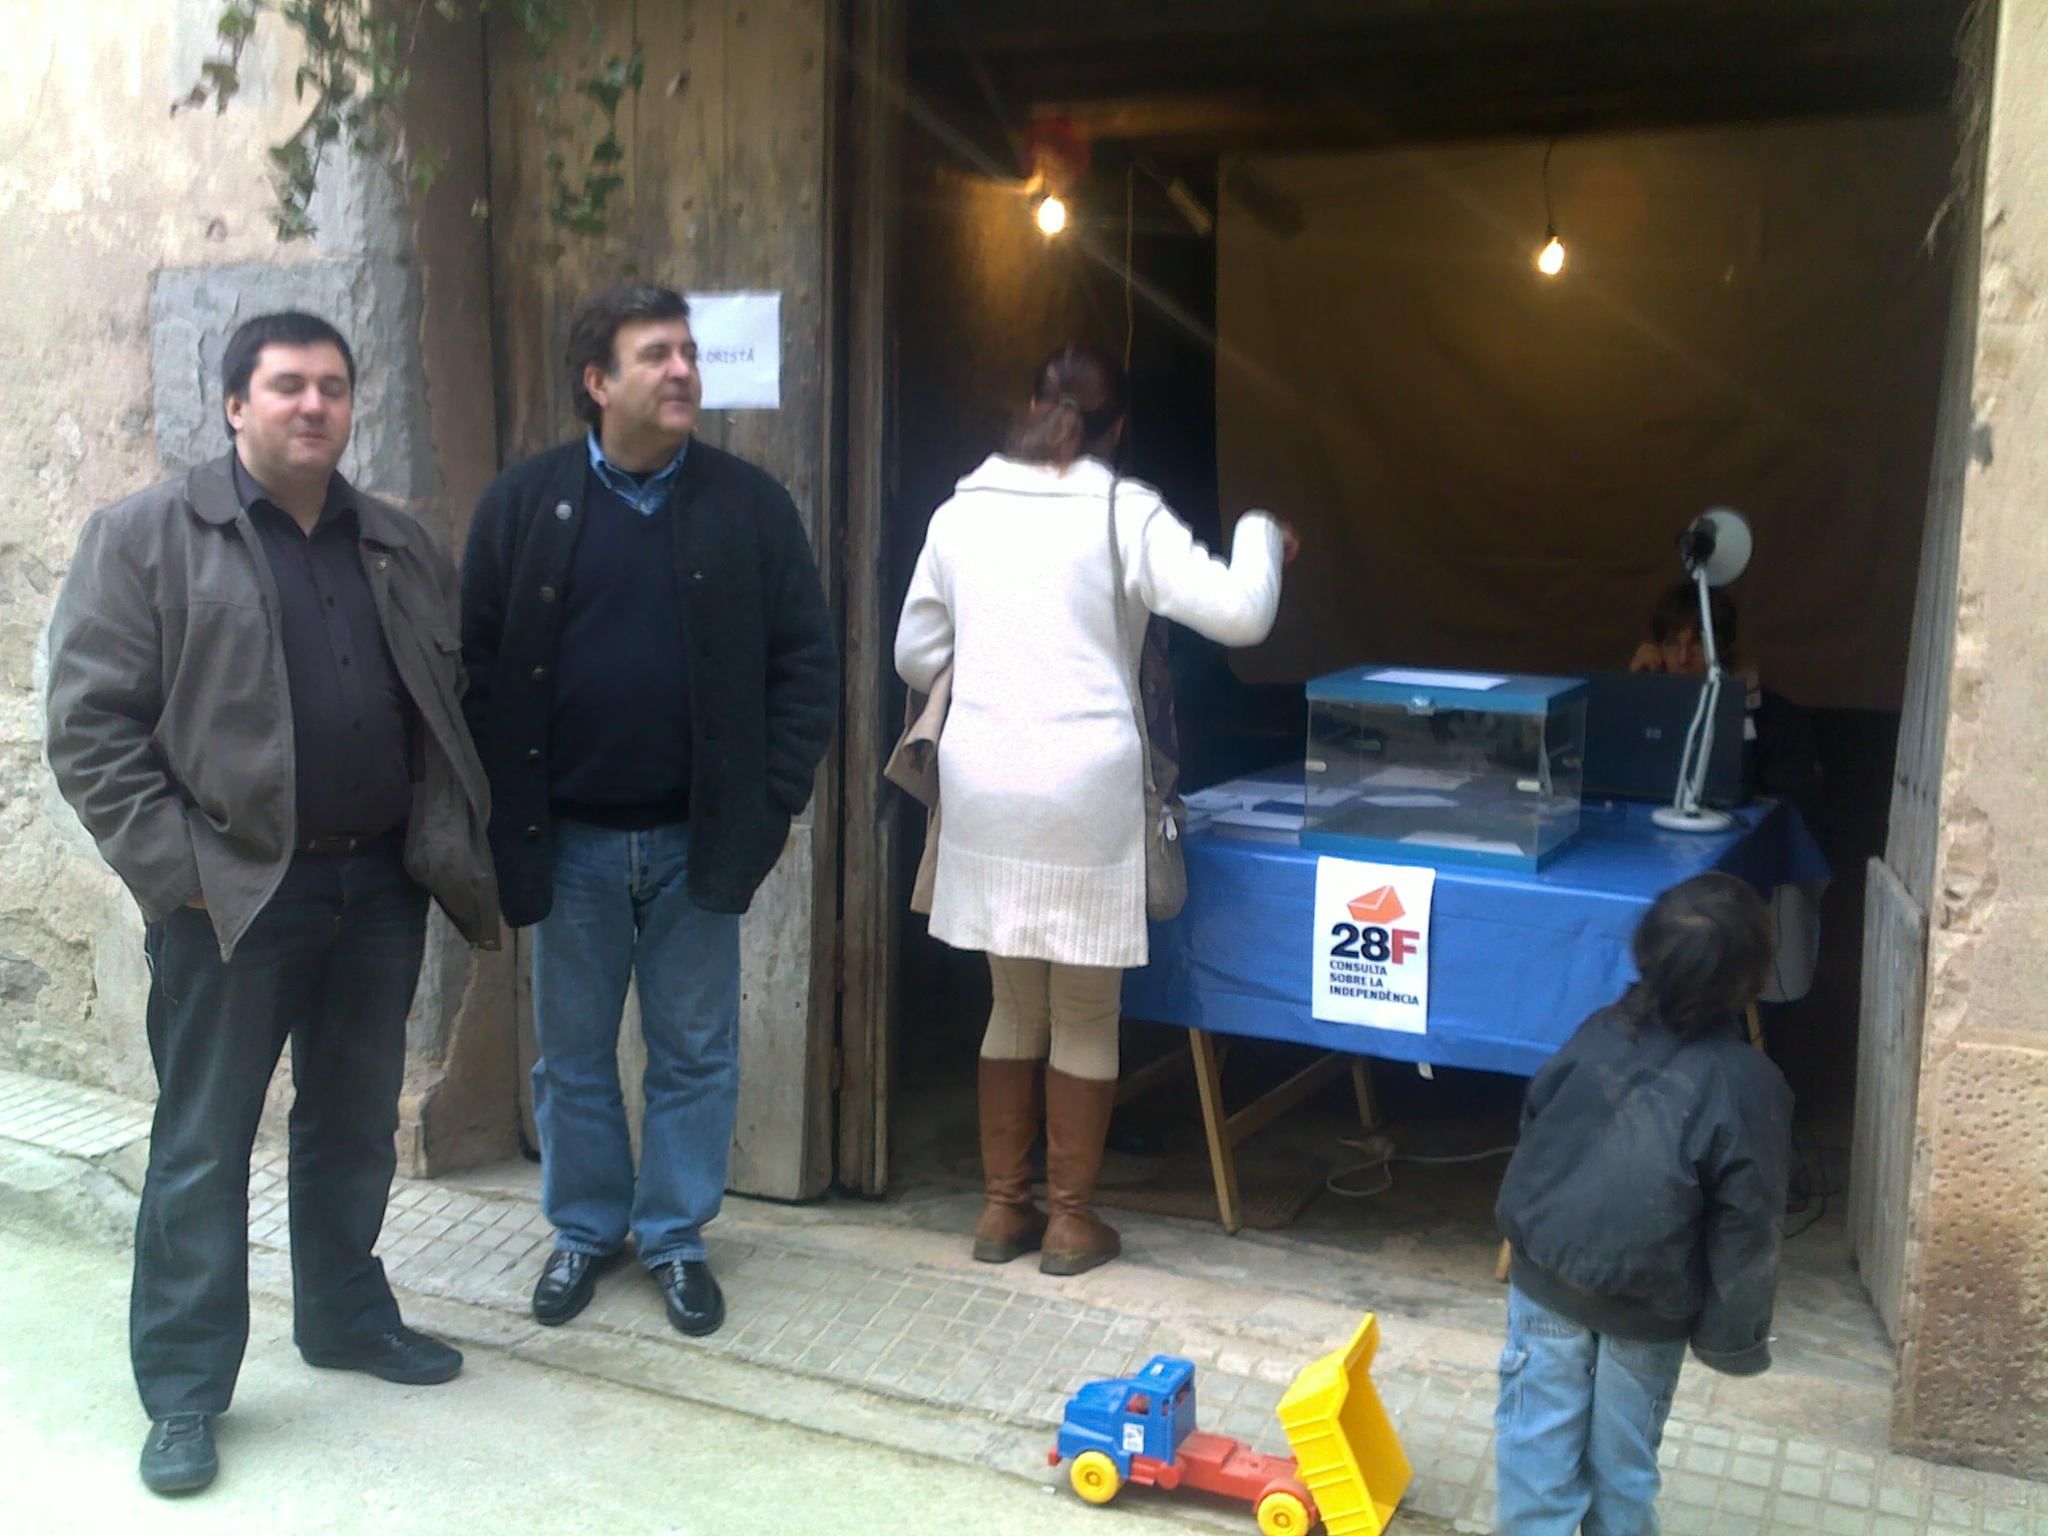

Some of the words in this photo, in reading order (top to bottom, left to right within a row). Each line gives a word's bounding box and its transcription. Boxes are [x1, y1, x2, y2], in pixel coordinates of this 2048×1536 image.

[1330, 922, 1420, 965] 28F
[1329, 960, 1387, 976] CONSULTA
[1329, 973, 1367, 987] SOBRE
[1369, 977, 1384, 988] LA
